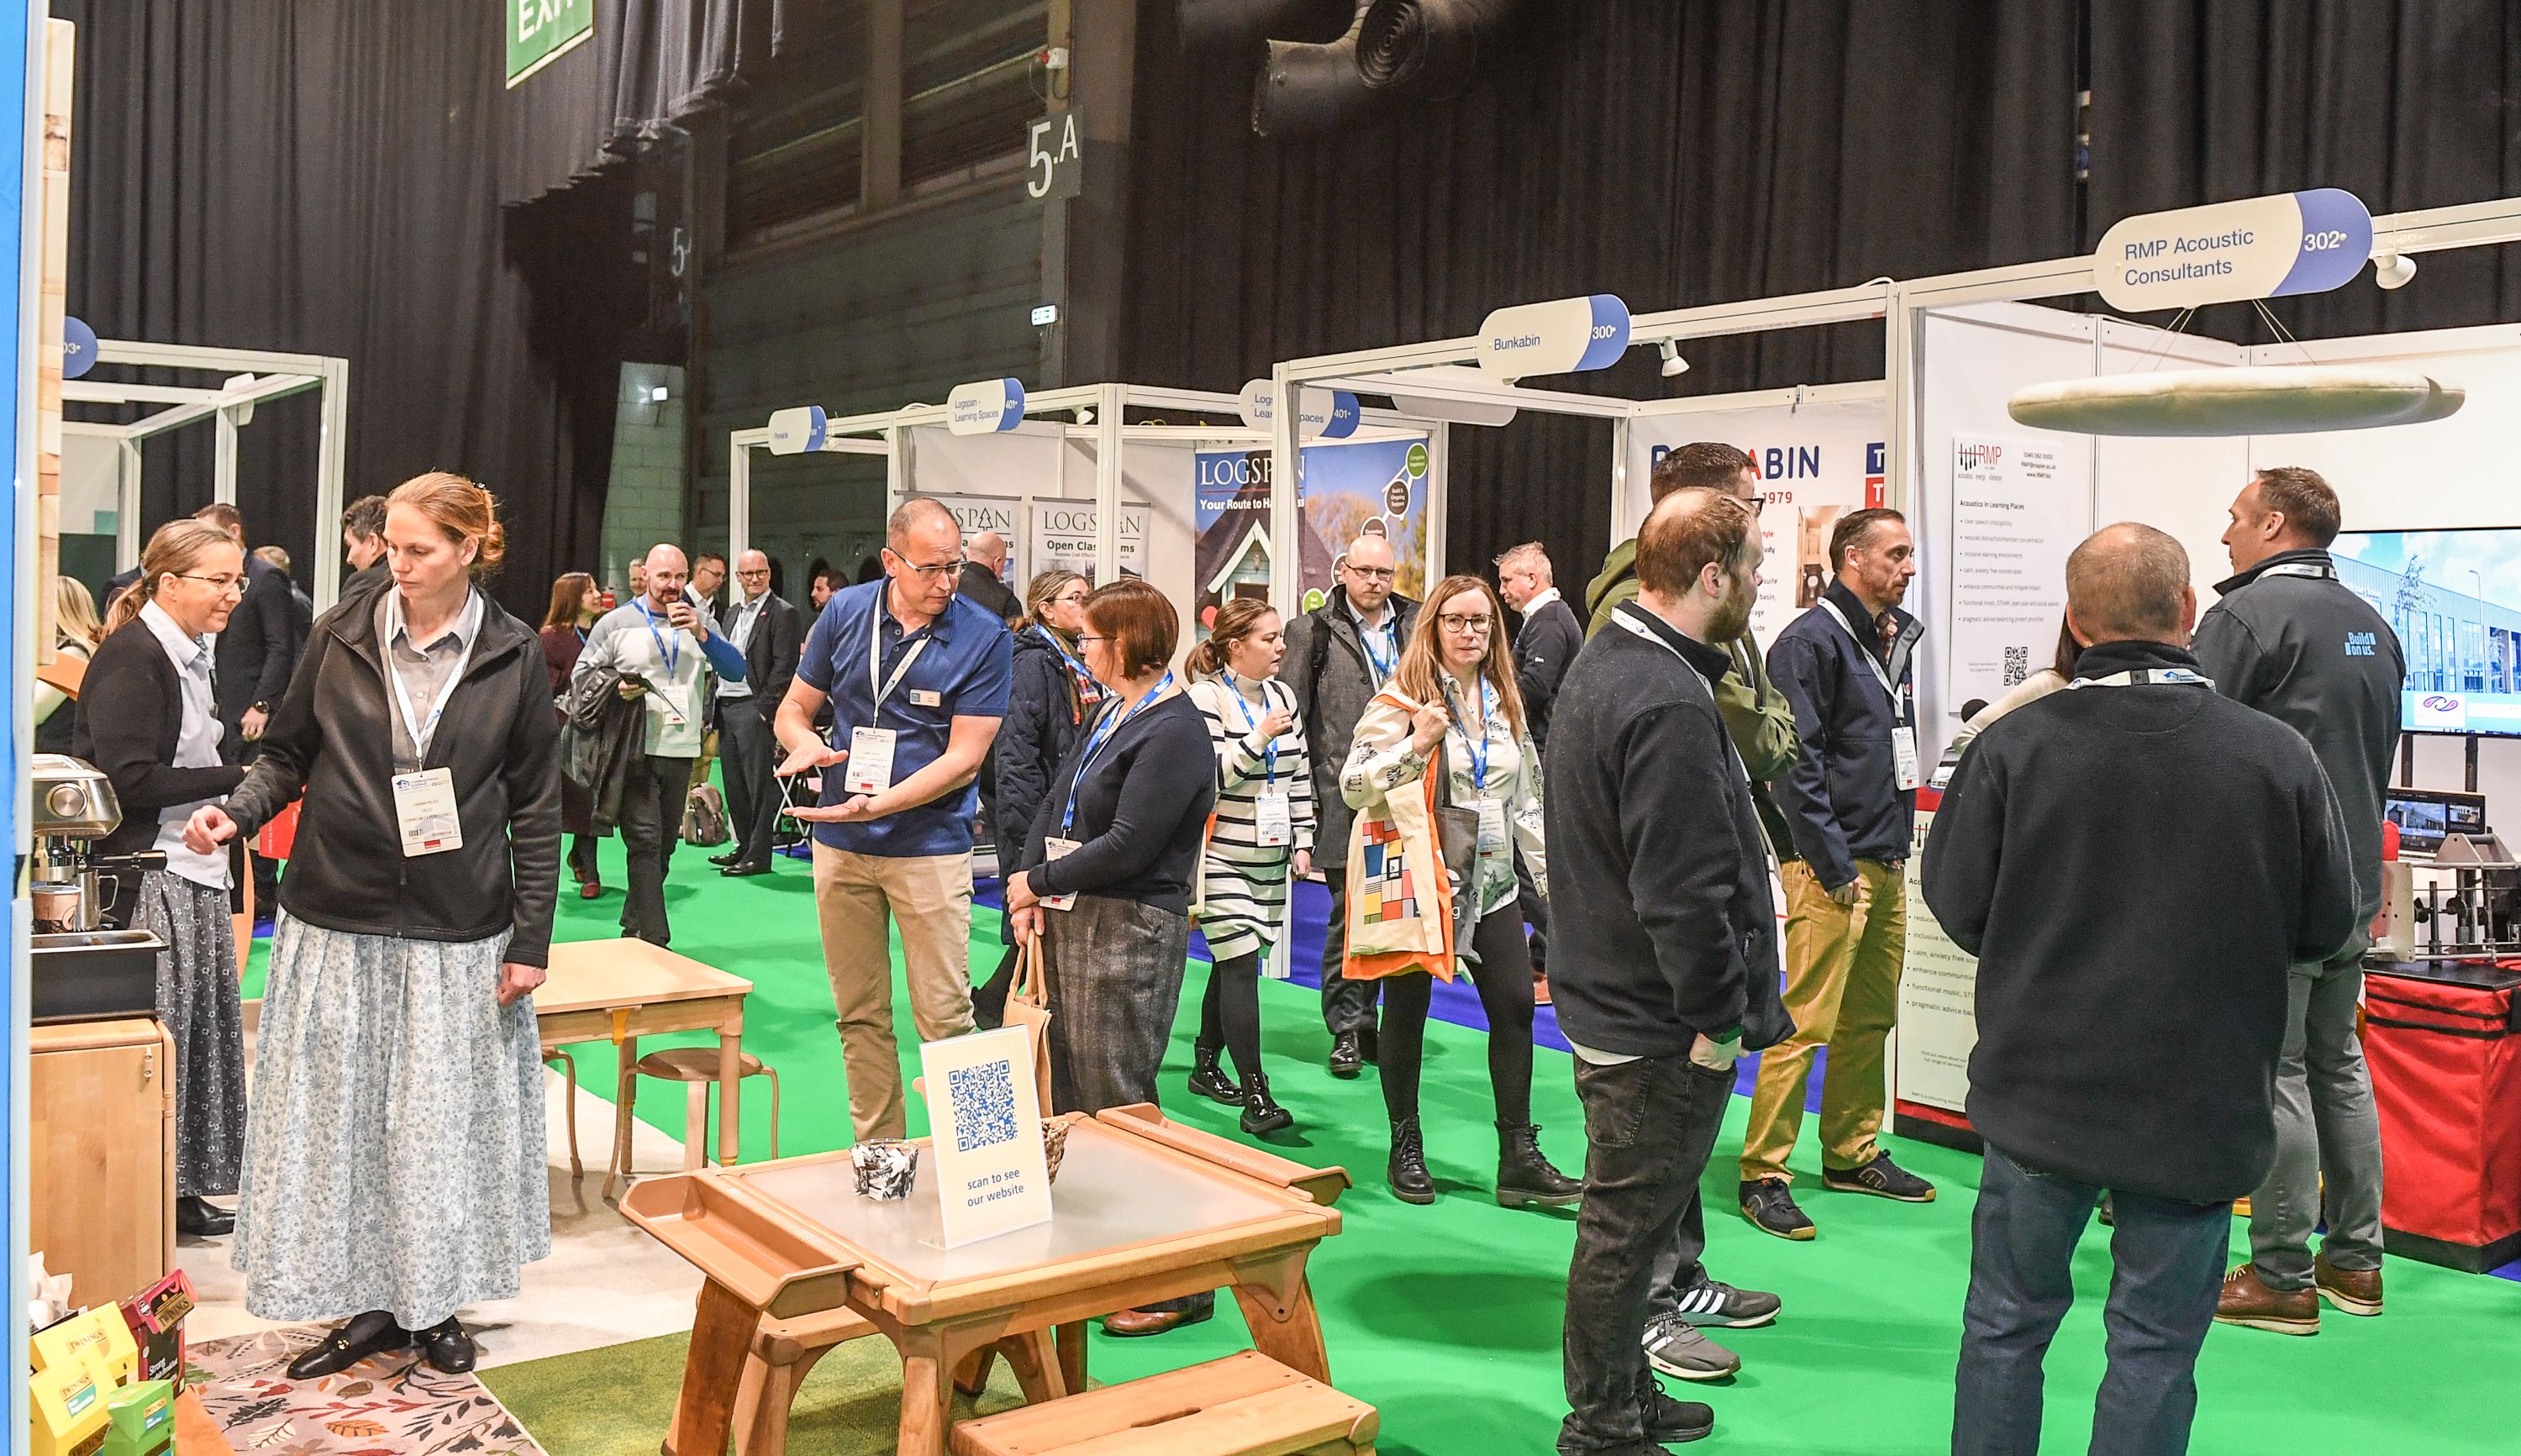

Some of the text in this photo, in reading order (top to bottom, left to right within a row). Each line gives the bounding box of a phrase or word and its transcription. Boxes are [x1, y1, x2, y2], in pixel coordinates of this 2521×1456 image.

[518, 0, 573, 43] EX
[1028, 114, 1078, 197] 5.A
[2125, 229, 2254, 260] RMP Acoustic
[2304, 231, 2340, 251] 302
[2125, 260, 2232, 286] Consultants
[1592, 325, 1613, 339] 300
[1494, 334, 1540, 350] Bunkabin
[955, 399, 977, 410] Logspan
[1006, 400, 1016, 410] 401
[955, 411, 998, 422] Learning Spaces
[1299, 413, 1324, 423] paces
[1334, 409, 1348, 418] 401
[1979, 444, 2002, 465] RMP
[1200, 499, 1225, 510] Your
[1227, 498, 1251, 510] Route
[1253, 499, 1262, 509] to
[1762, 491, 1792, 504] 1979
[1990, 502, 2009, 510] Learning
[1047, 540, 1073, 551] Open
[2348, 632, 2370, 645] Build
[2351, 645, 2375, 655] on us.
[1913, 933, 1939, 941] inclusive
[1913, 949, 1928, 958] calm,
[1929, 952, 1950, 961] anxiety
[1952, 954, 1965, 962] free
[1913, 966, 1975, 980] enhance communitie
[1912, 982, 1942, 992] functional
[1943, 989, 1962, 997] music,
[1912, 1001, 1940, 1011] pragmatic
[1943, 1005, 1962, 1013] advice
[967, 1169, 1020, 1190] scan to see
[967, 1184, 1024, 1207] our website
[158, 1301, 190, 1327] TWININGS
[70, 1330, 103, 1350] TWININGS
[62, 1376, 89, 1397] TWININGS
